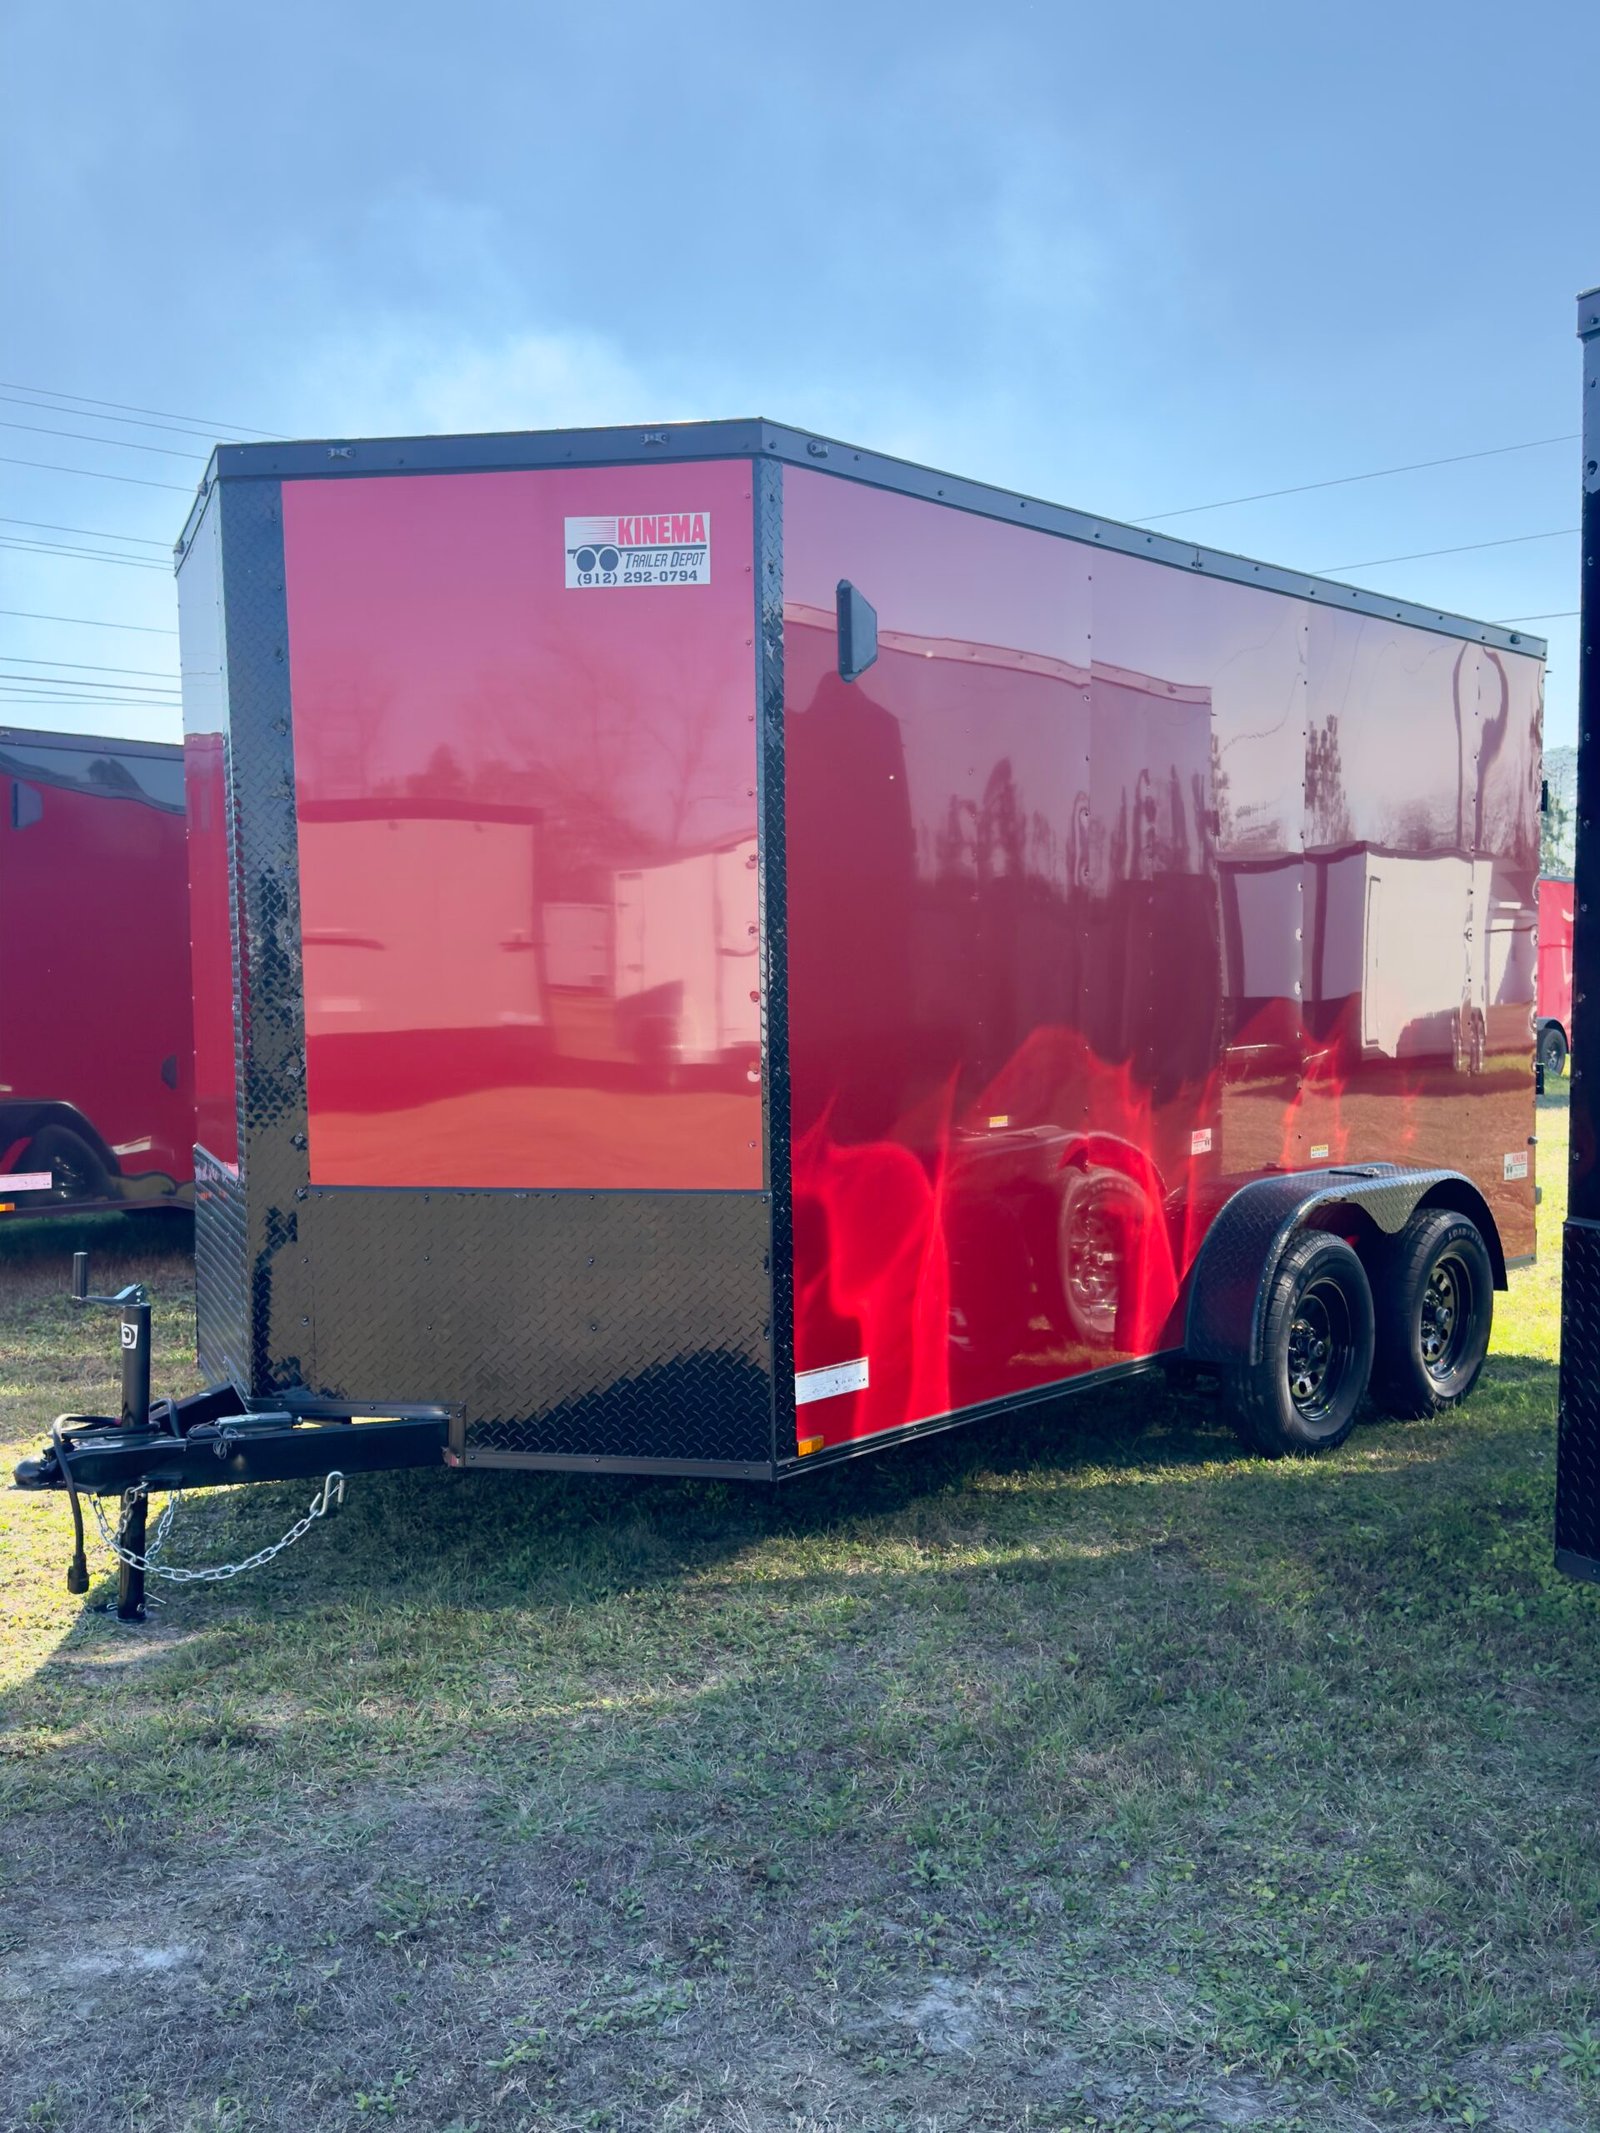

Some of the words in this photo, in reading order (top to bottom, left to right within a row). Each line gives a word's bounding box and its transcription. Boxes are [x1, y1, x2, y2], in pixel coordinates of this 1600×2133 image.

[618, 514, 707, 546] KINEMA
[625, 552, 668, 569] TRAILER
[670, 551, 706, 568] DEPOT
[577, 572, 618, 586] (912)
[623, 570, 698, 583] 292-0794
